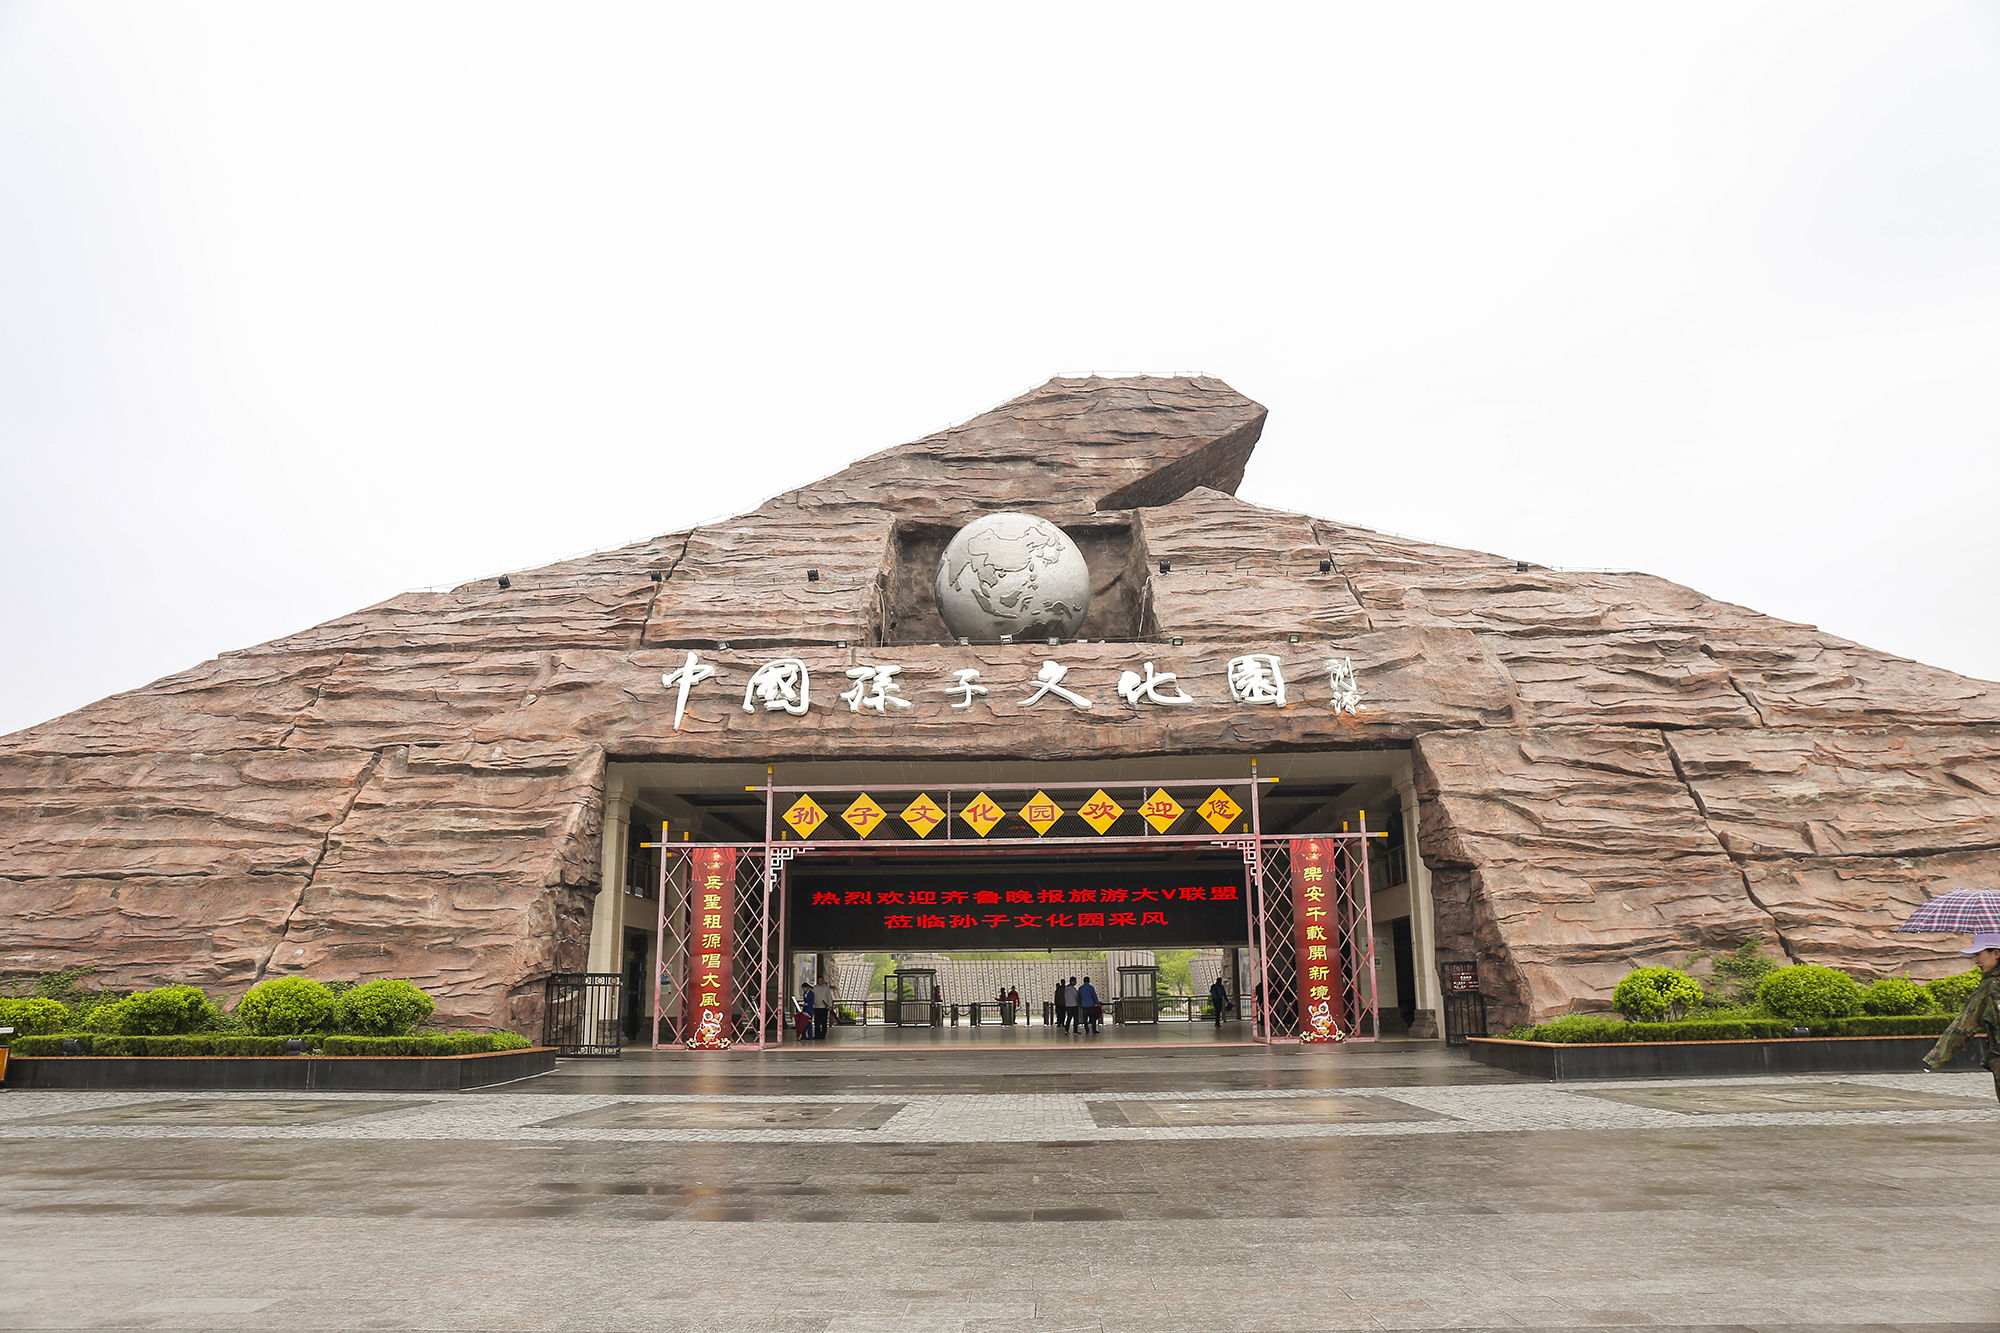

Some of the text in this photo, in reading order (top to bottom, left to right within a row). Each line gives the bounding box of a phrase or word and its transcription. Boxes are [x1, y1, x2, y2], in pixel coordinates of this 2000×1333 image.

[792, 799, 1235, 826] 孙子文化园欢迎您
[811, 886, 1239, 905] 热烈欢迎齐鲁晚报旅游大V联盟
[884, 912, 1169, 928] 莅临孙子文化园采风
[1303, 866, 1331, 1001] 樂安千載開新境
[699, 875, 724, 1007] 兵聖祖源唱大風
